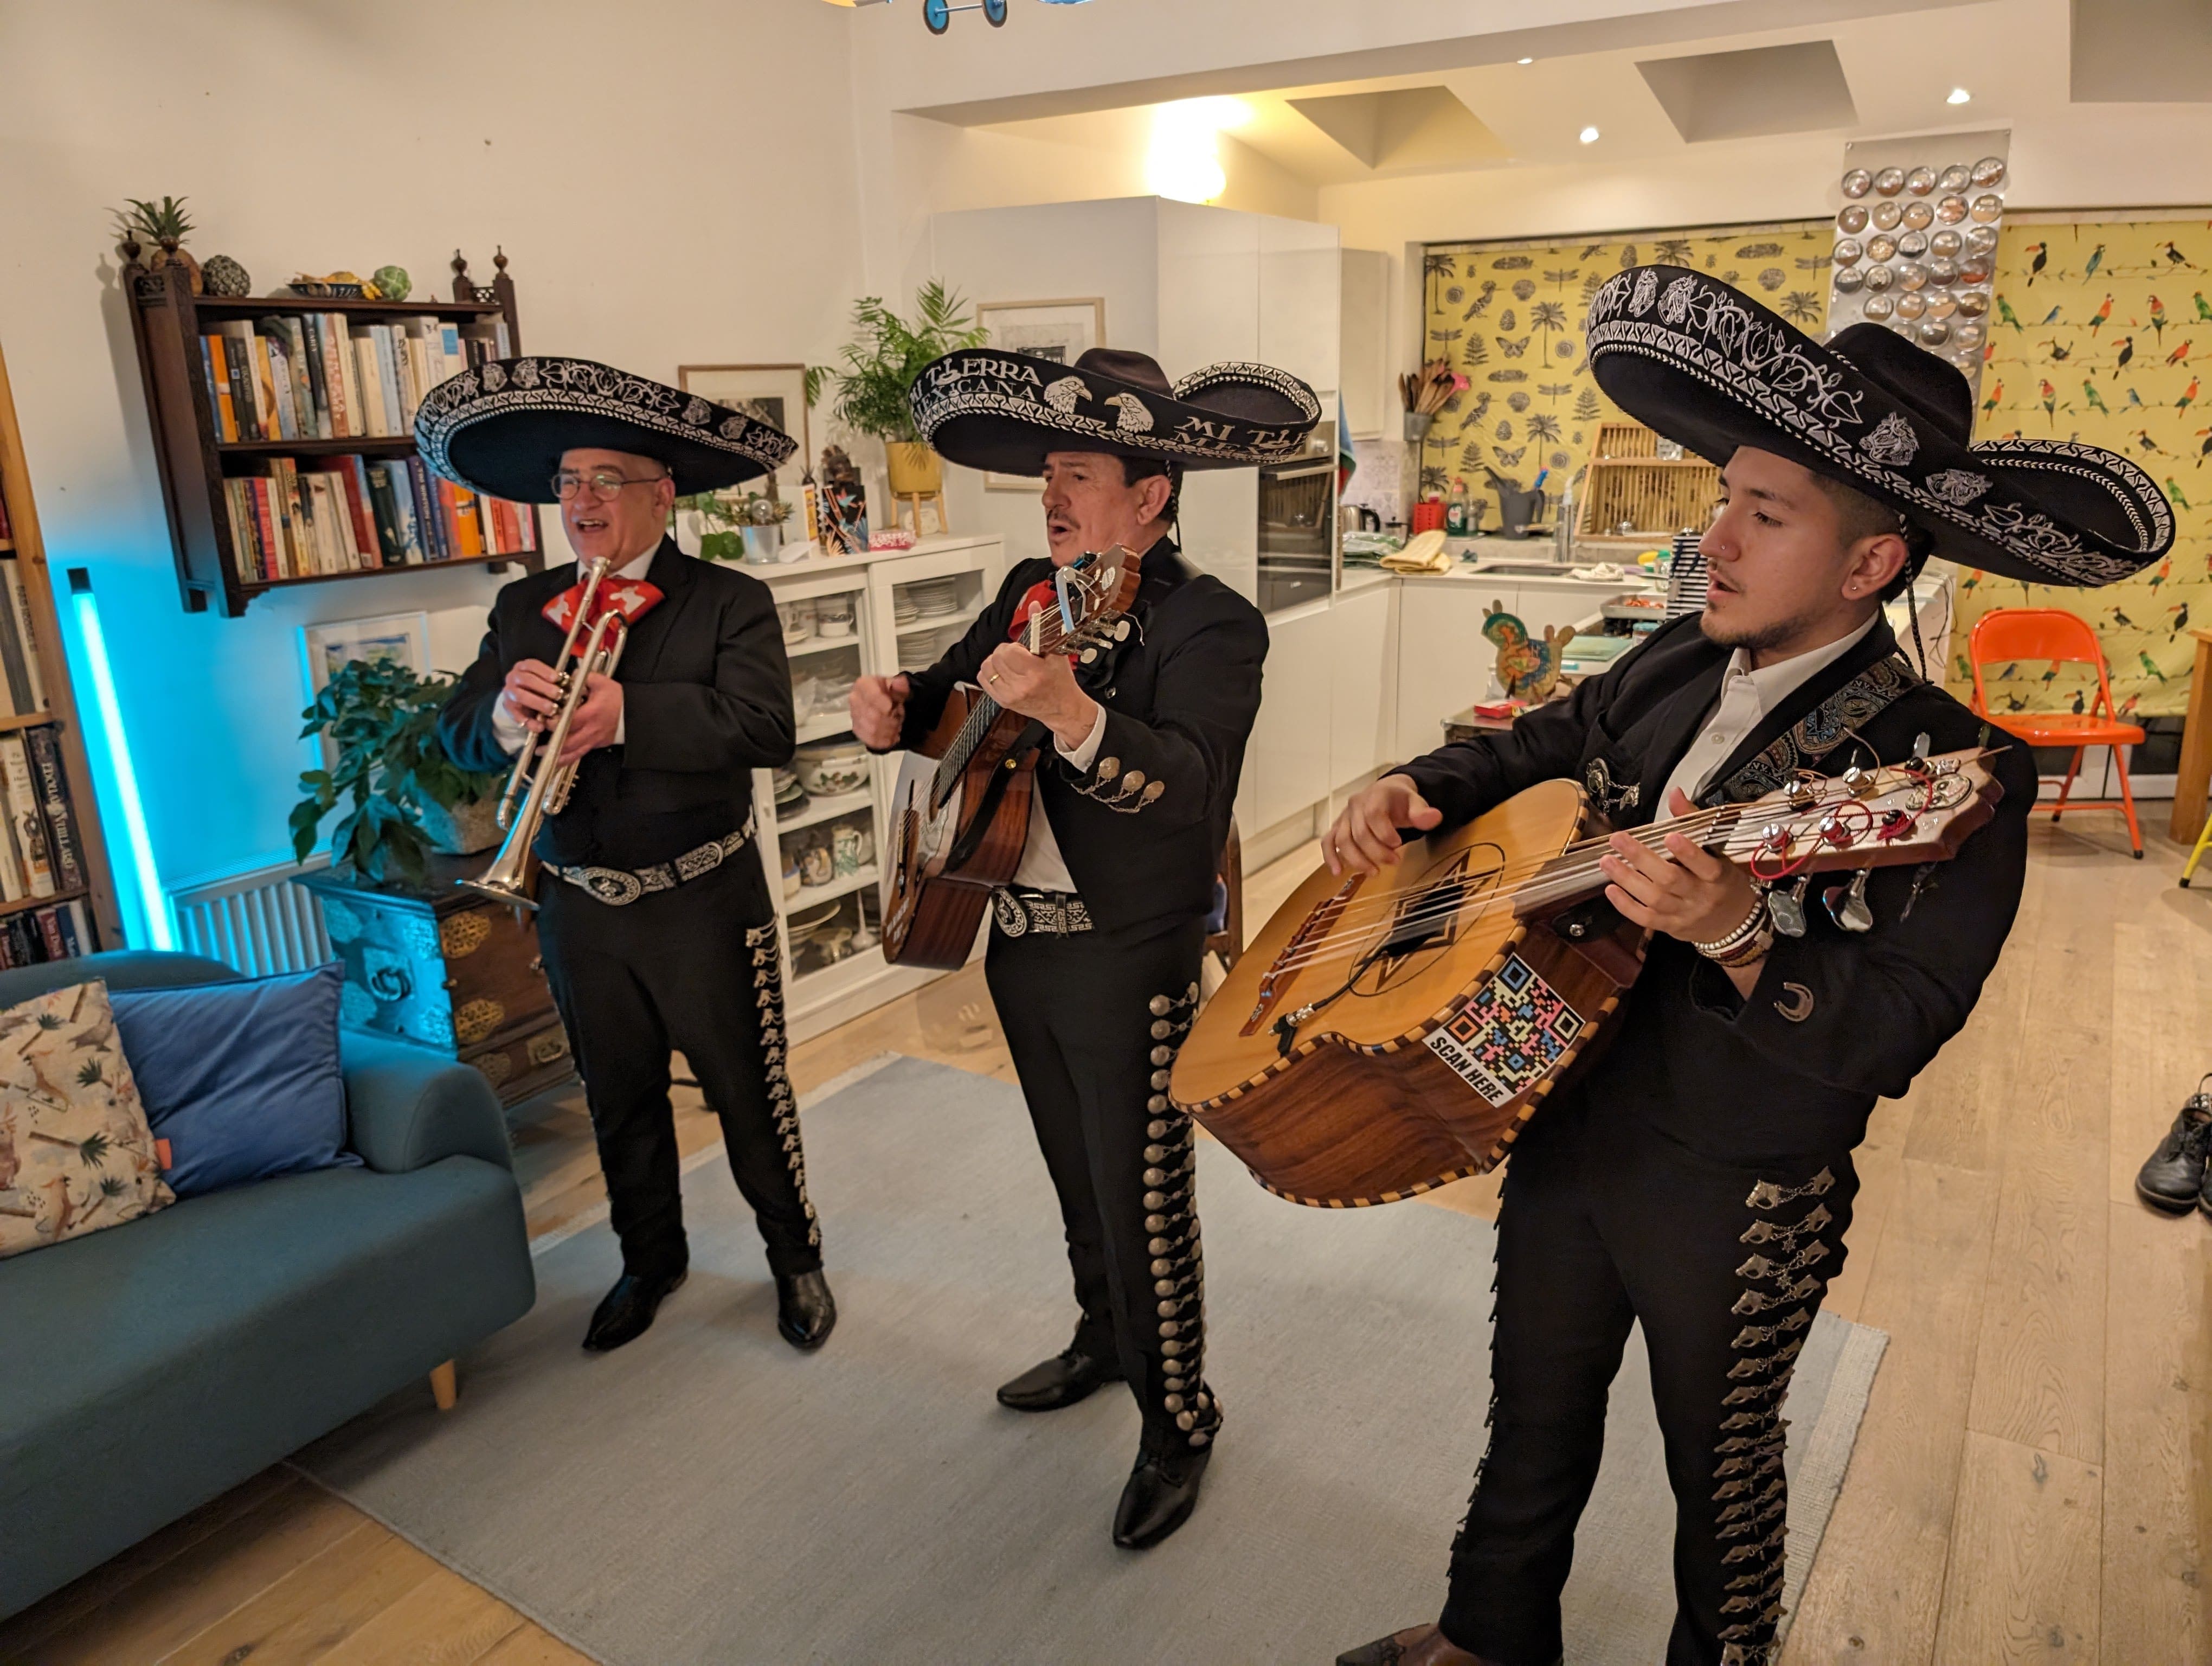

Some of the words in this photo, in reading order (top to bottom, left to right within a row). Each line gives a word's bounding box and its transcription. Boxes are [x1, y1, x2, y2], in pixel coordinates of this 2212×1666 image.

[925, 357, 1044, 387] TIERRA
[912, 378, 1038, 422] MEXICANA
[1173, 416, 1236, 441] MI
[1430, 1036, 1472, 1072] SCAN
[1464, 1068, 1504, 1101] HERE
